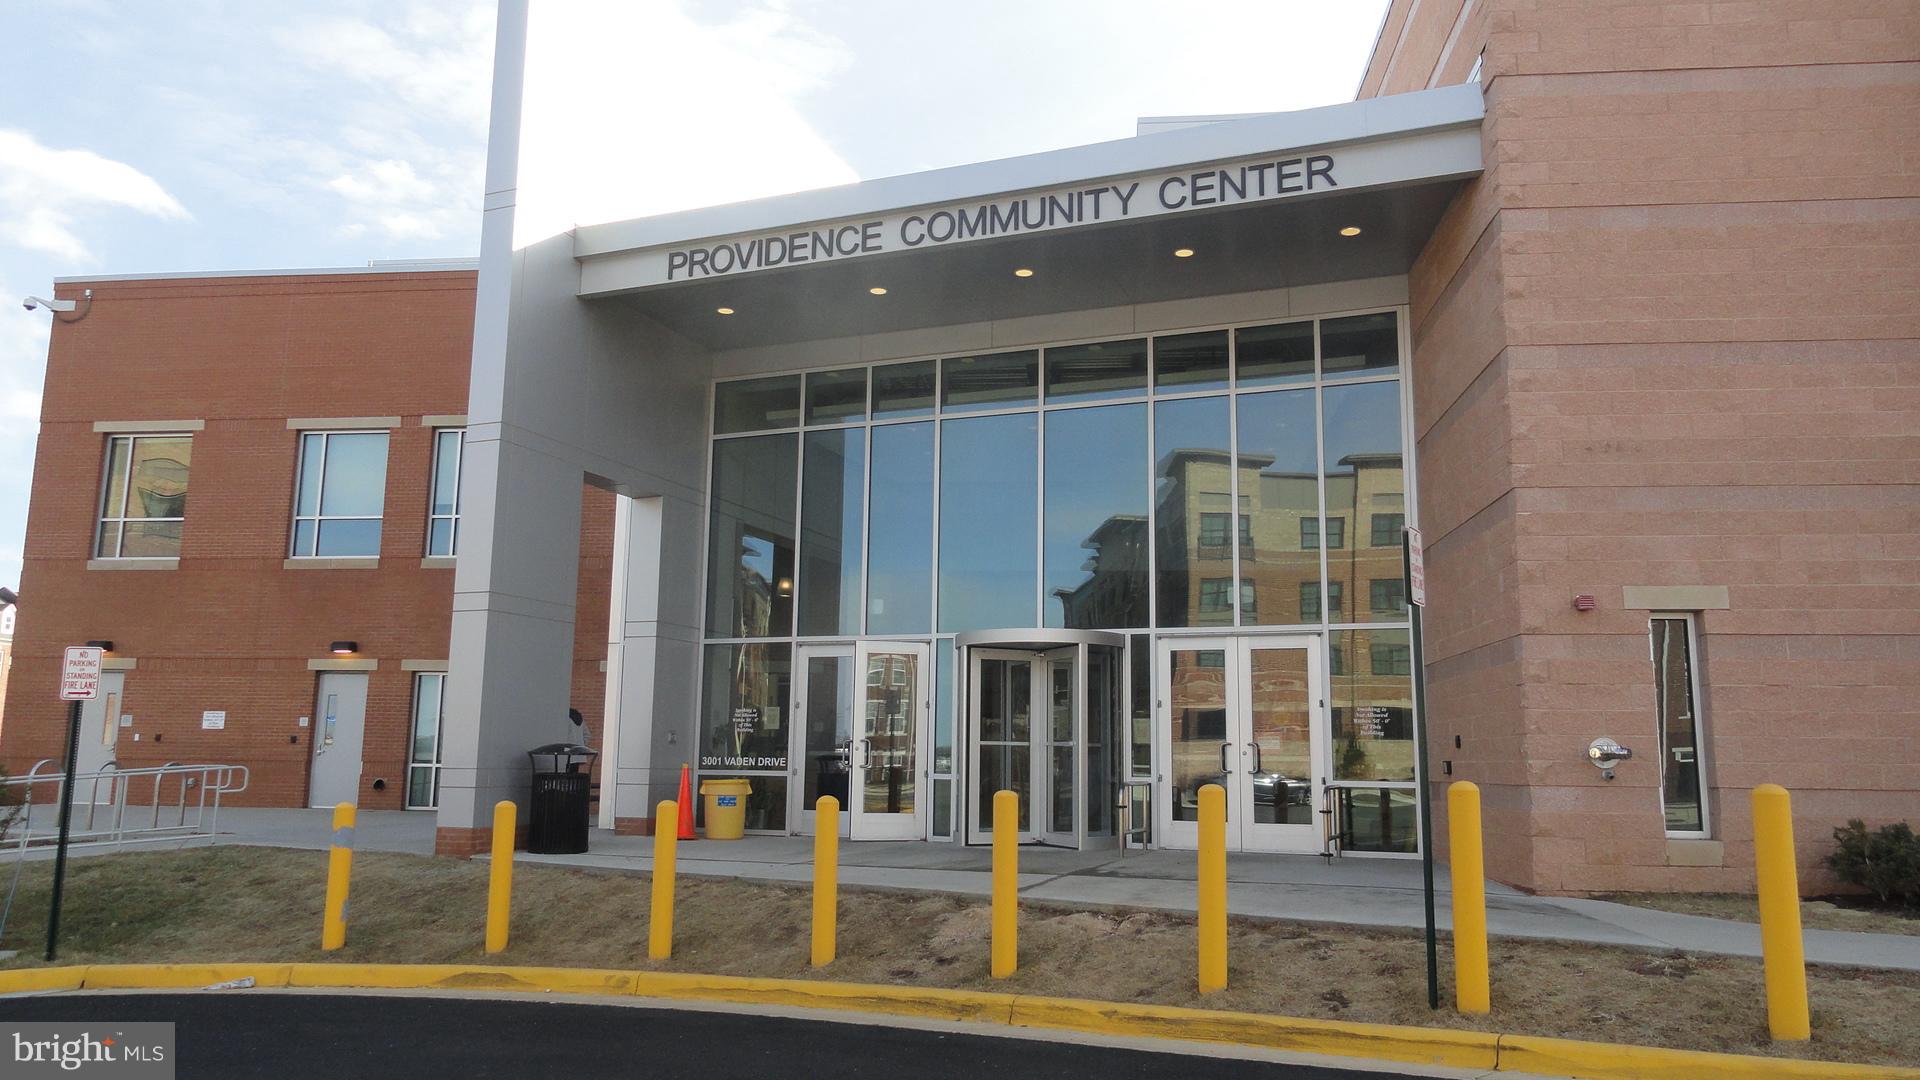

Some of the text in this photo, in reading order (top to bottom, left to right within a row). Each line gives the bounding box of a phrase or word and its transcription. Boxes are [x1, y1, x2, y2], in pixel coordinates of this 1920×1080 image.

[667, 154, 1337, 280] PROVIDENCE COMMUNITY CENTER
[79, 650, 89, 658] NO
[64, 681, 97, 690] FIRE LANE
[702, 756, 787, 767] 3001 VADEN DRIVE
